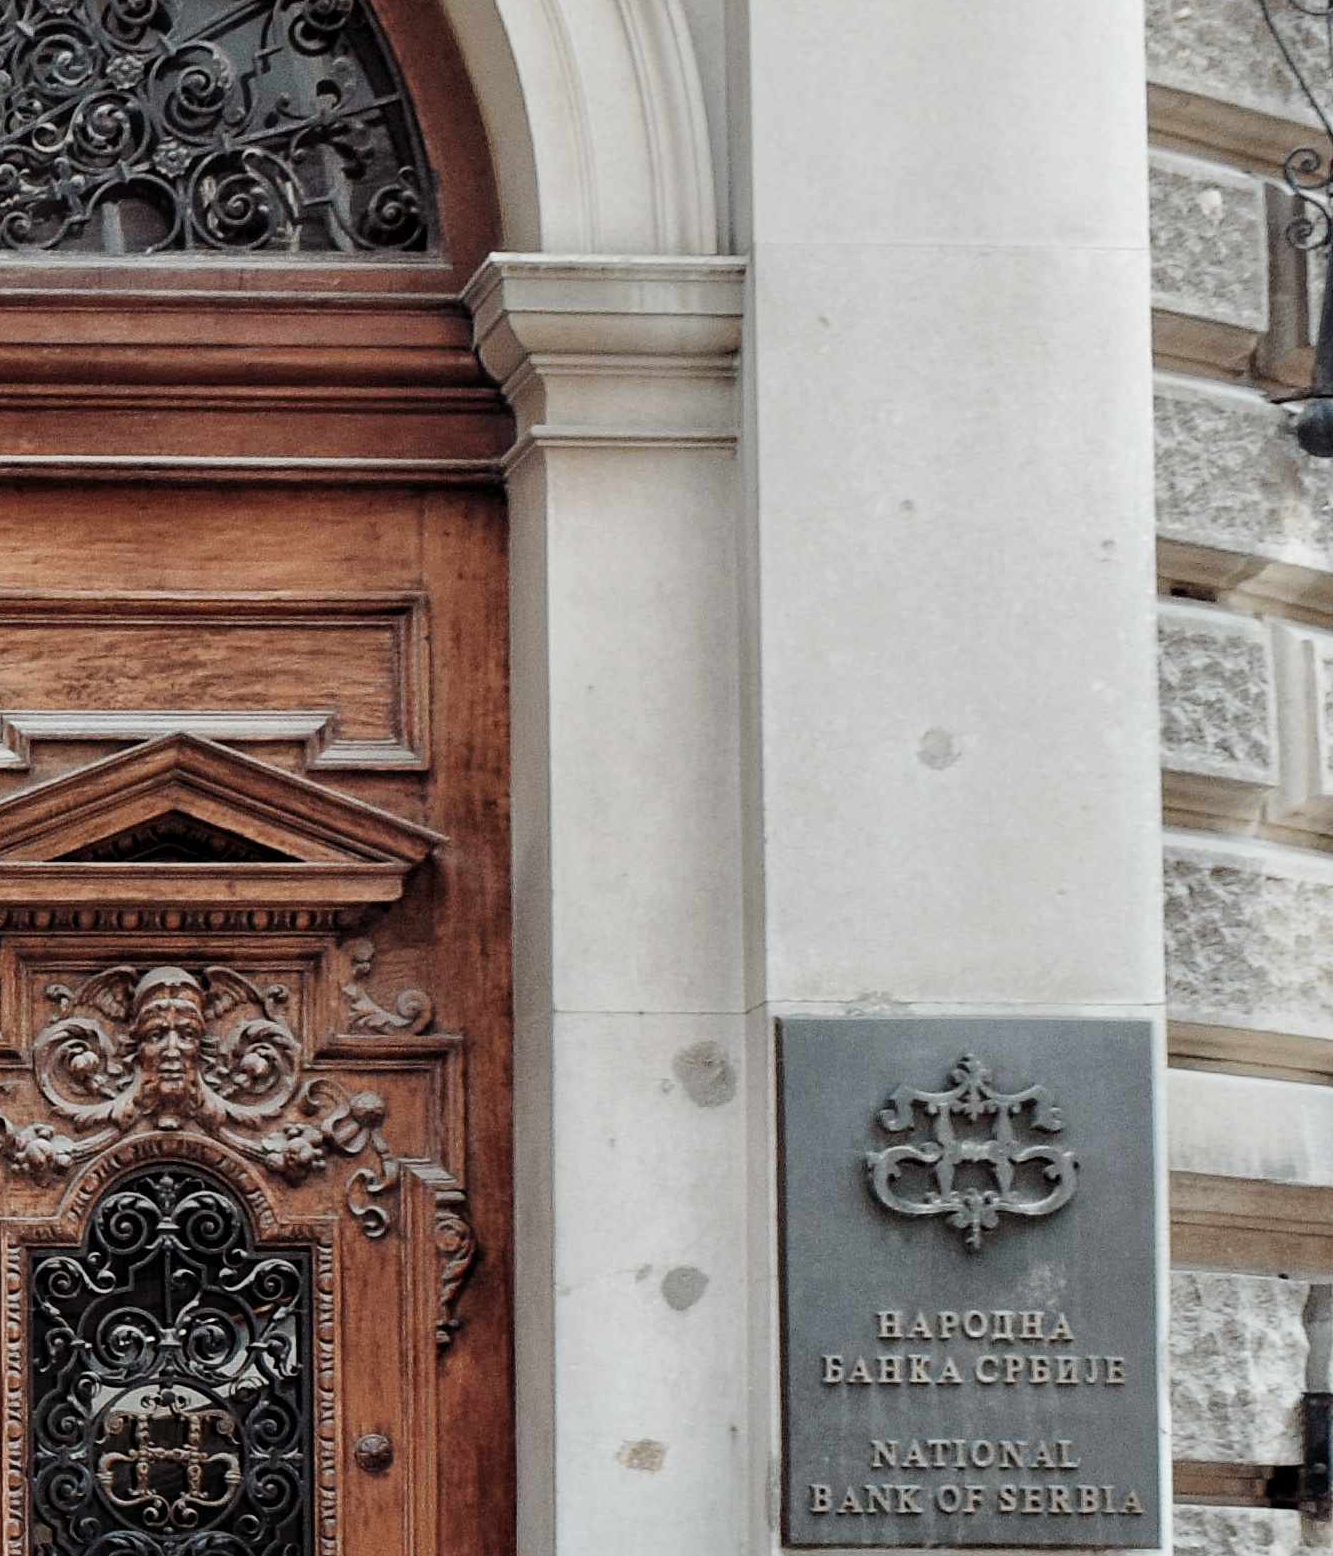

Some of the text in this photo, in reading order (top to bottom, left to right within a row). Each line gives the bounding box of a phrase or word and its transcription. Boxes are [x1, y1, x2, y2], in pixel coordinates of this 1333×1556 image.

[876, 1309, 1076, 1342] НАРОДНА
[821, 1354, 1127, 1385] БАНКА СРБИЈЕ
[870, 1438, 1082, 1469] NATIONAL
[809, 1483, 1146, 1516] BANK OF SERBIA
